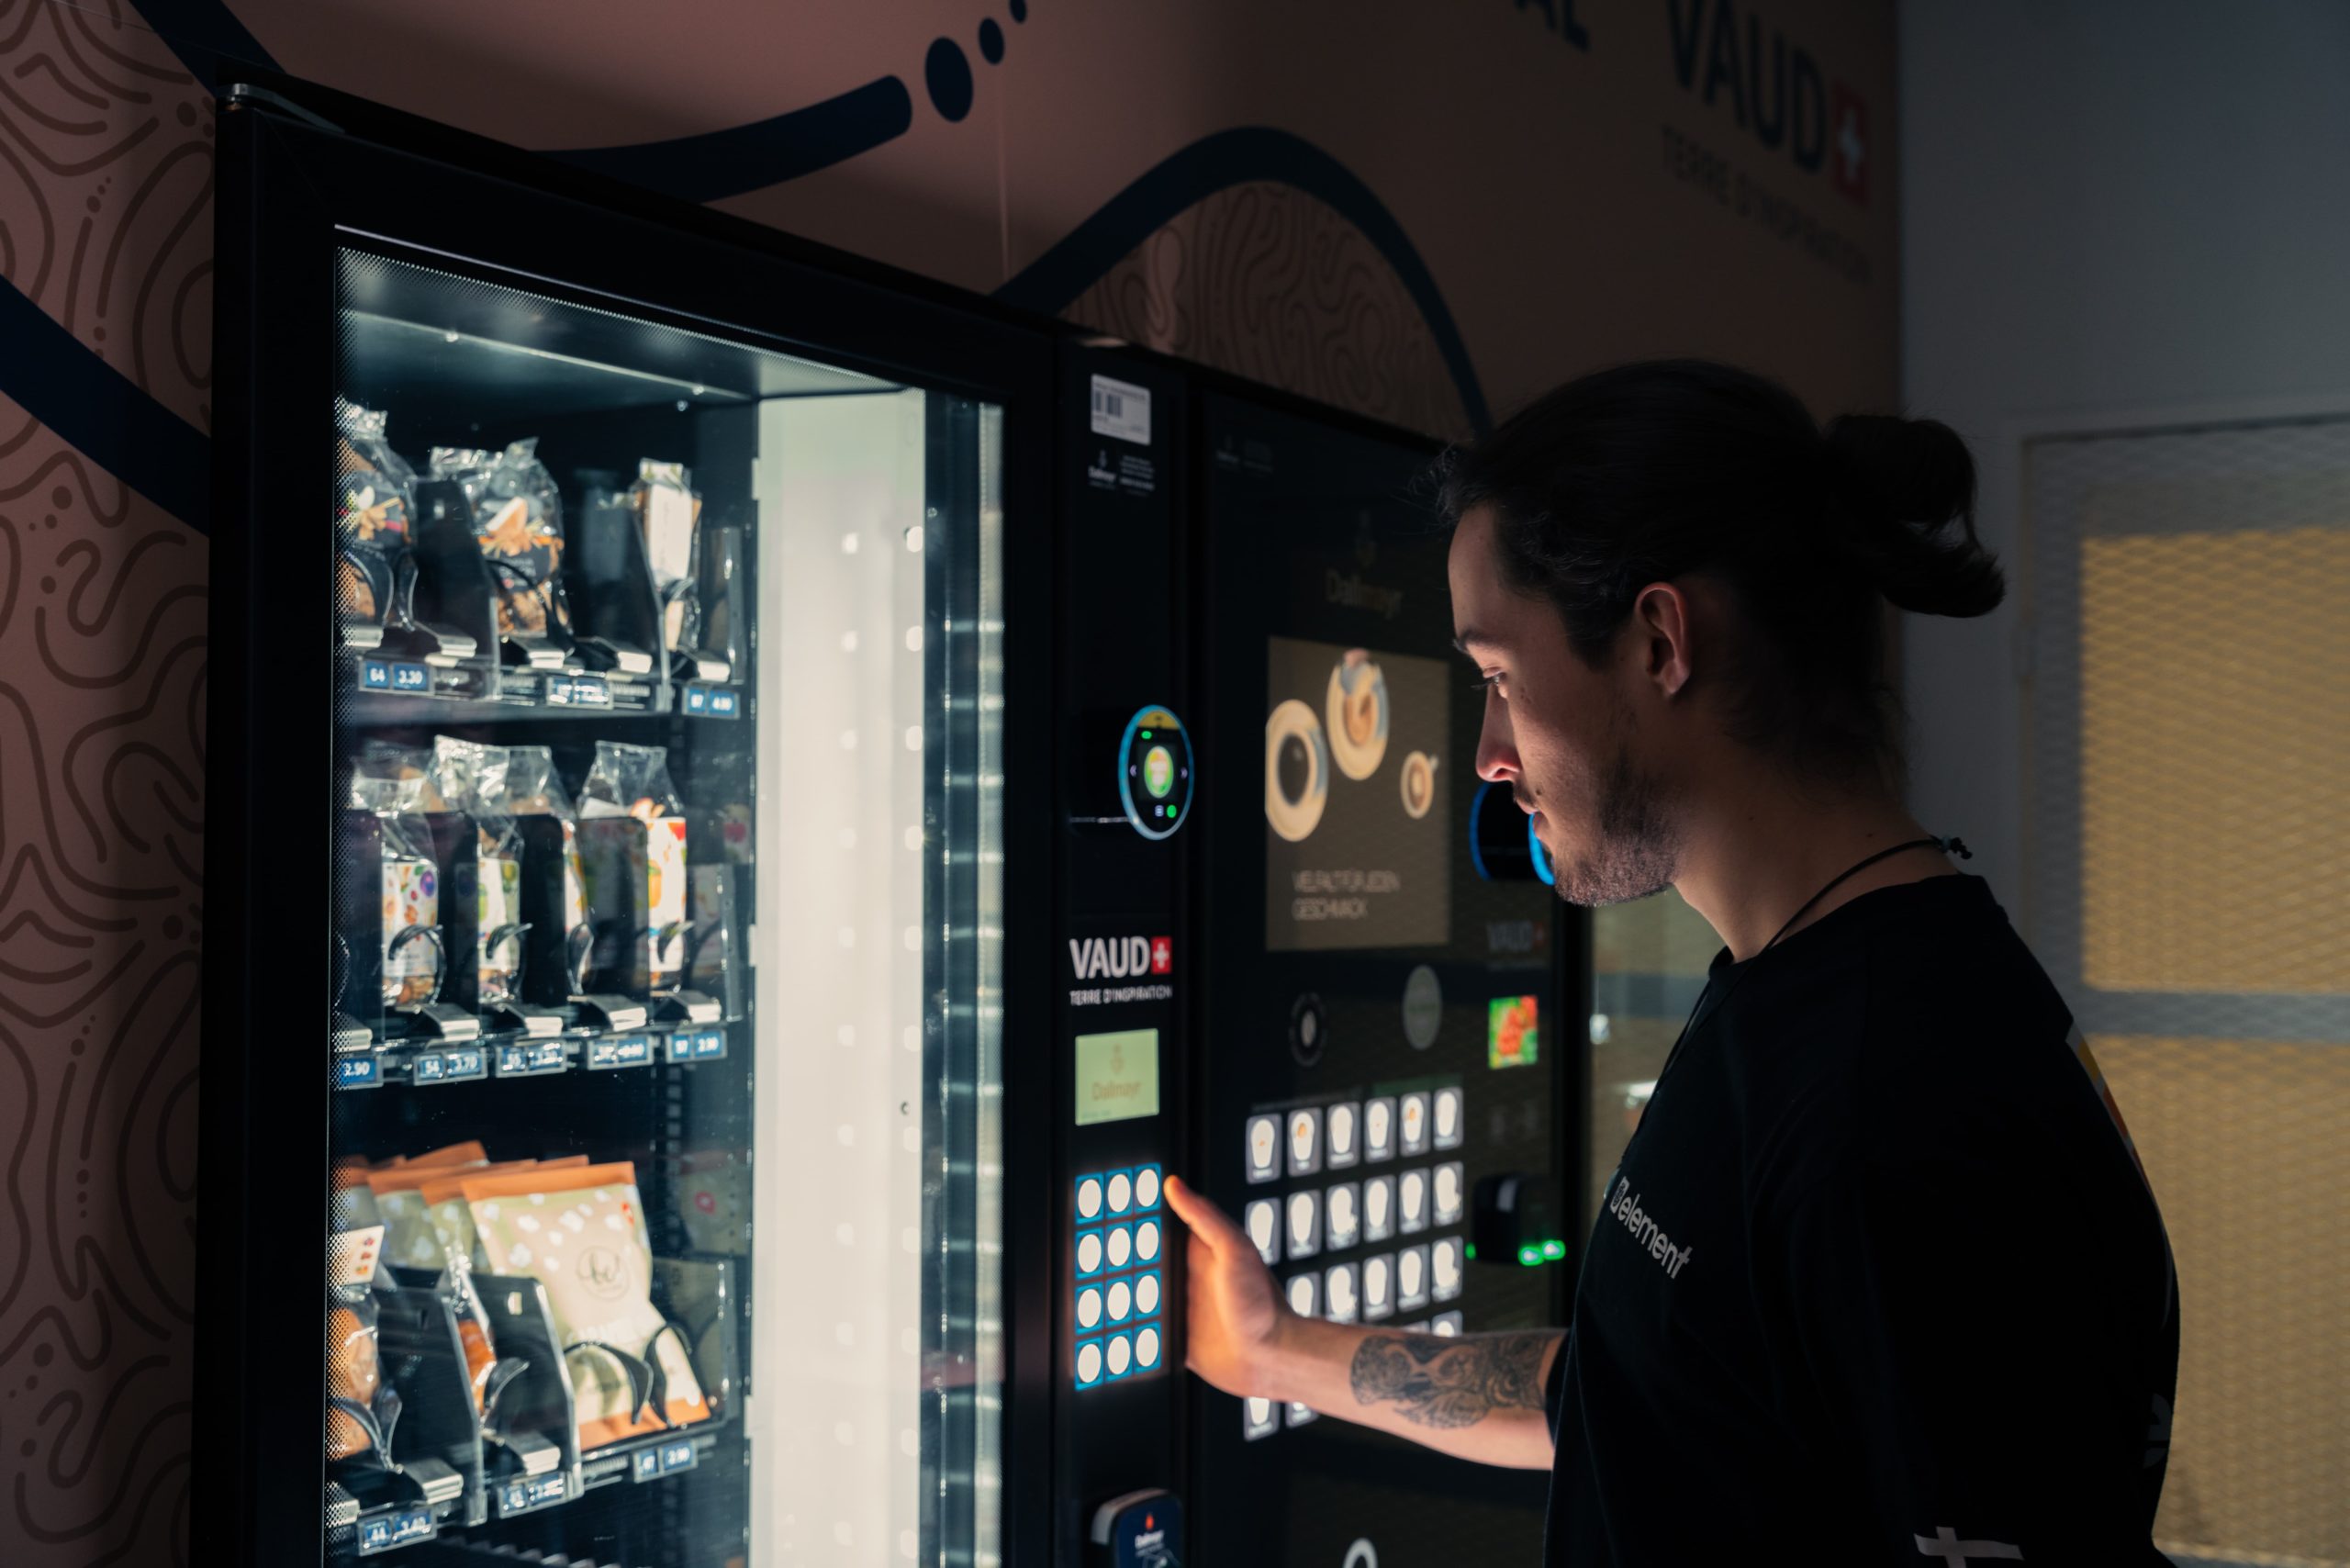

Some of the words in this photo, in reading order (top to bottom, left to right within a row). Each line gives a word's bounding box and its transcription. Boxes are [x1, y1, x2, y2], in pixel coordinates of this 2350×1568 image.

[1665, 0, 1828, 174] VAUD
[1662, 122, 1729, 207] TERRE
[1325, 568, 1404, 621] Dallmayr
[1069, 935, 1150, 980] VAUD
[1069, 989, 1102, 1006] TERRE
[1102, 984, 1173, 1004] D'INSPIRATION
[1617, 1193, 1693, 1280] element
